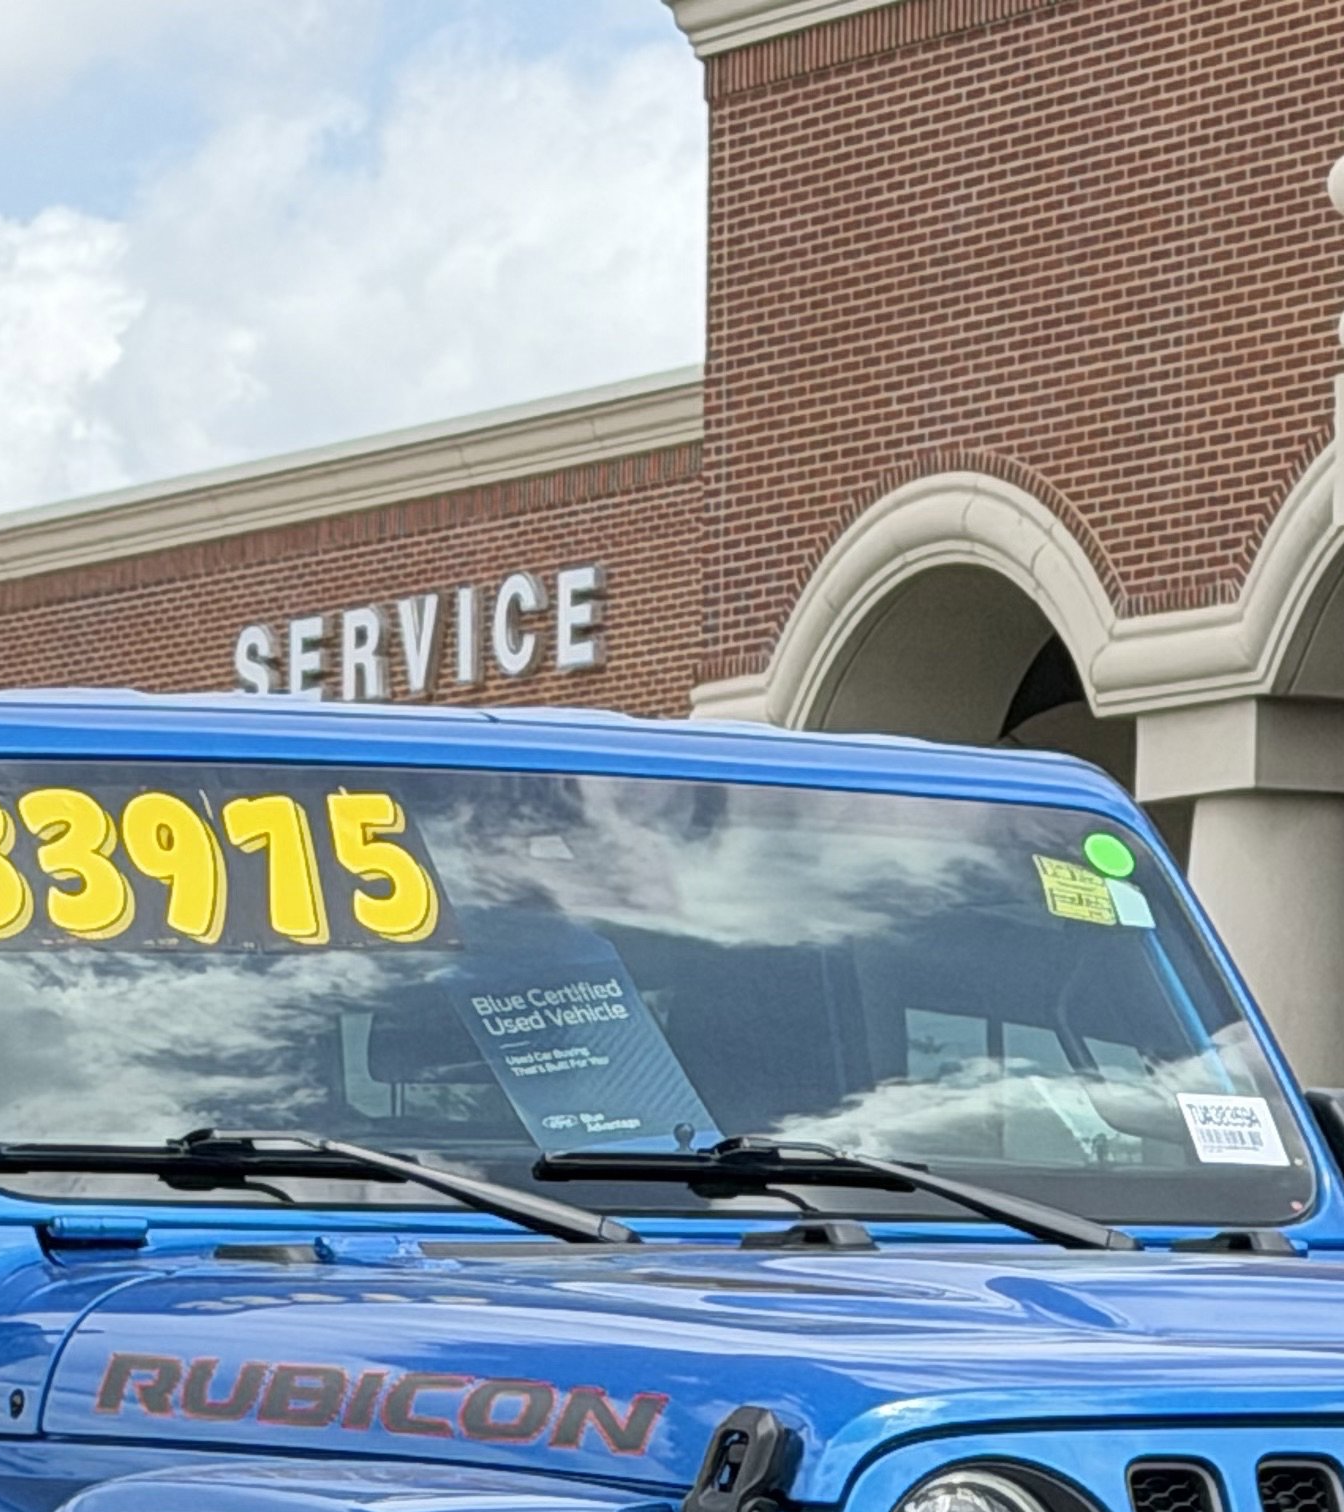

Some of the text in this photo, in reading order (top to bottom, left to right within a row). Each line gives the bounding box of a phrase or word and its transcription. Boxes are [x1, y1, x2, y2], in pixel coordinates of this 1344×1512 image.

[234, 563, 606, 702] SERVICE
[472, 978, 624, 1017] Blue Certified
[481, 1002, 629, 1036] Used Vehicle
[95, 1352, 669, 1456] RUBICON
